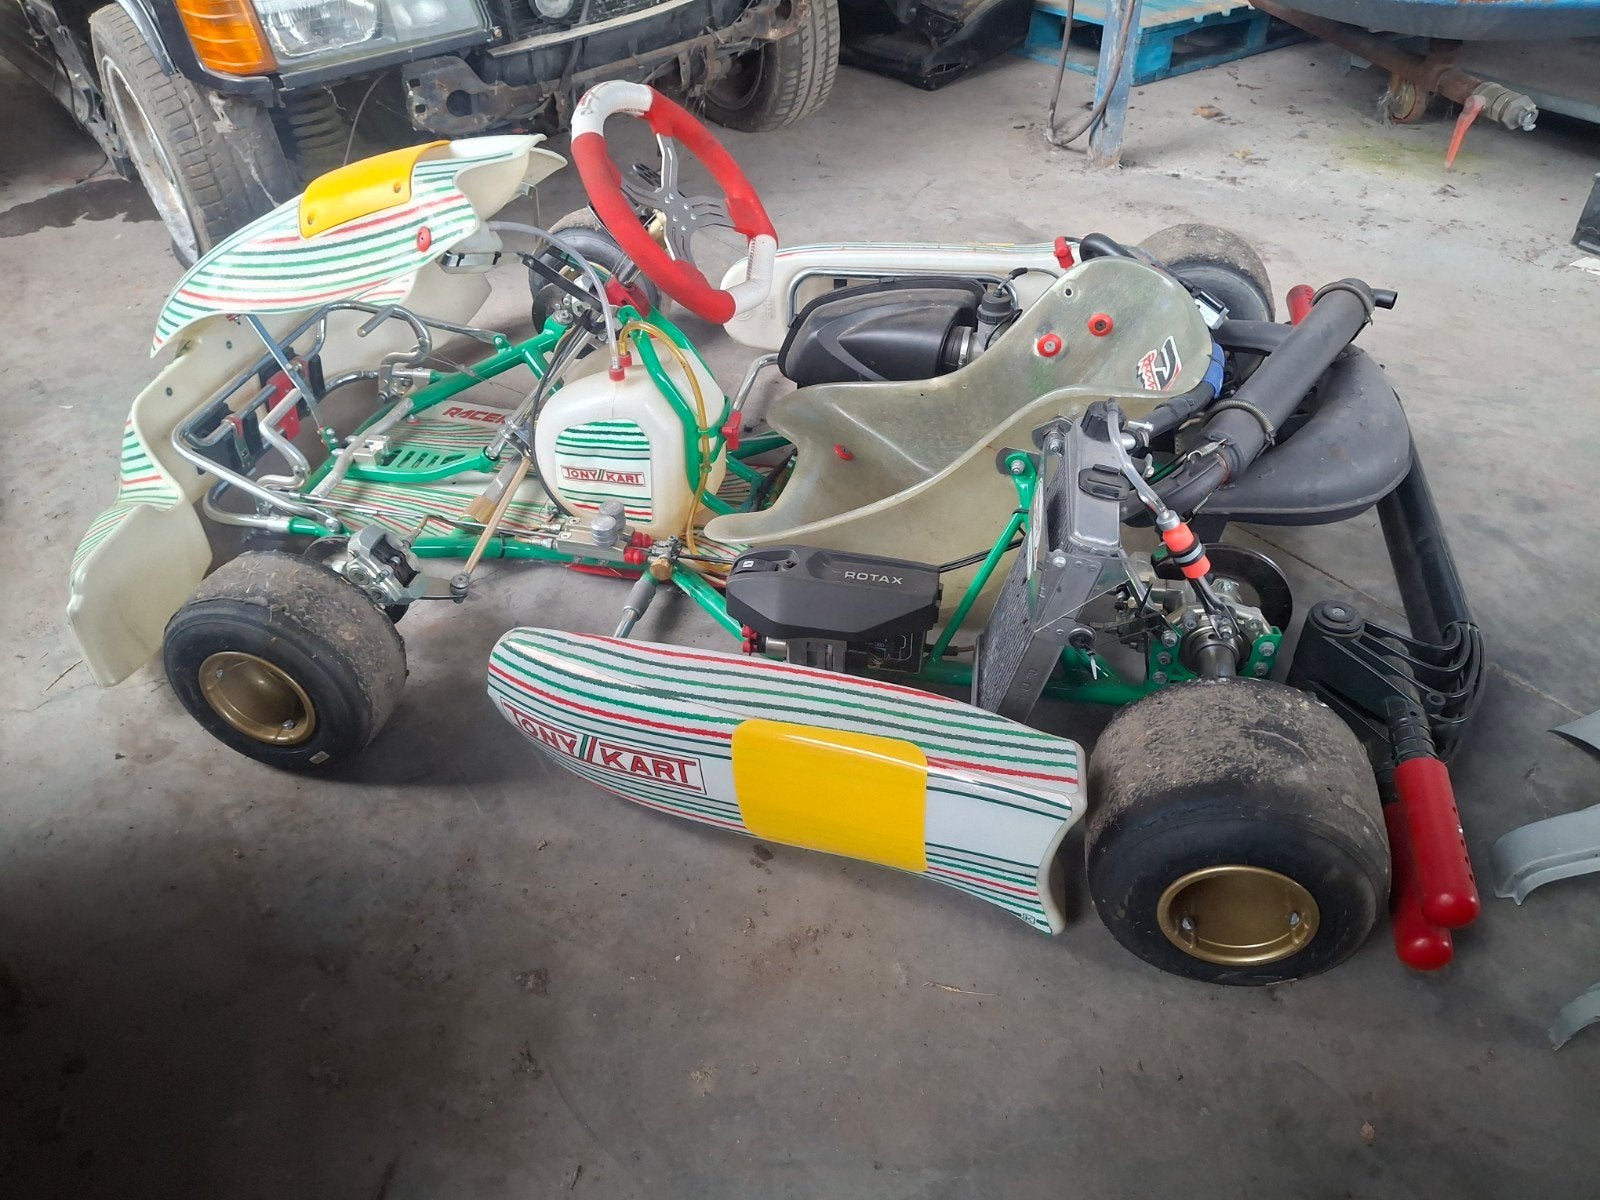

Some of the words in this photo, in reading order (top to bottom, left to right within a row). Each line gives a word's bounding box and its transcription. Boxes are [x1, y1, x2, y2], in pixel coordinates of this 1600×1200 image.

[562, 466, 599, 480] TONY
[605, 471, 643, 484] KART
[844, 571, 904, 585] ROTAX
[504, 703, 577, 753] TONY
[599, 742, 696, 783] KART
